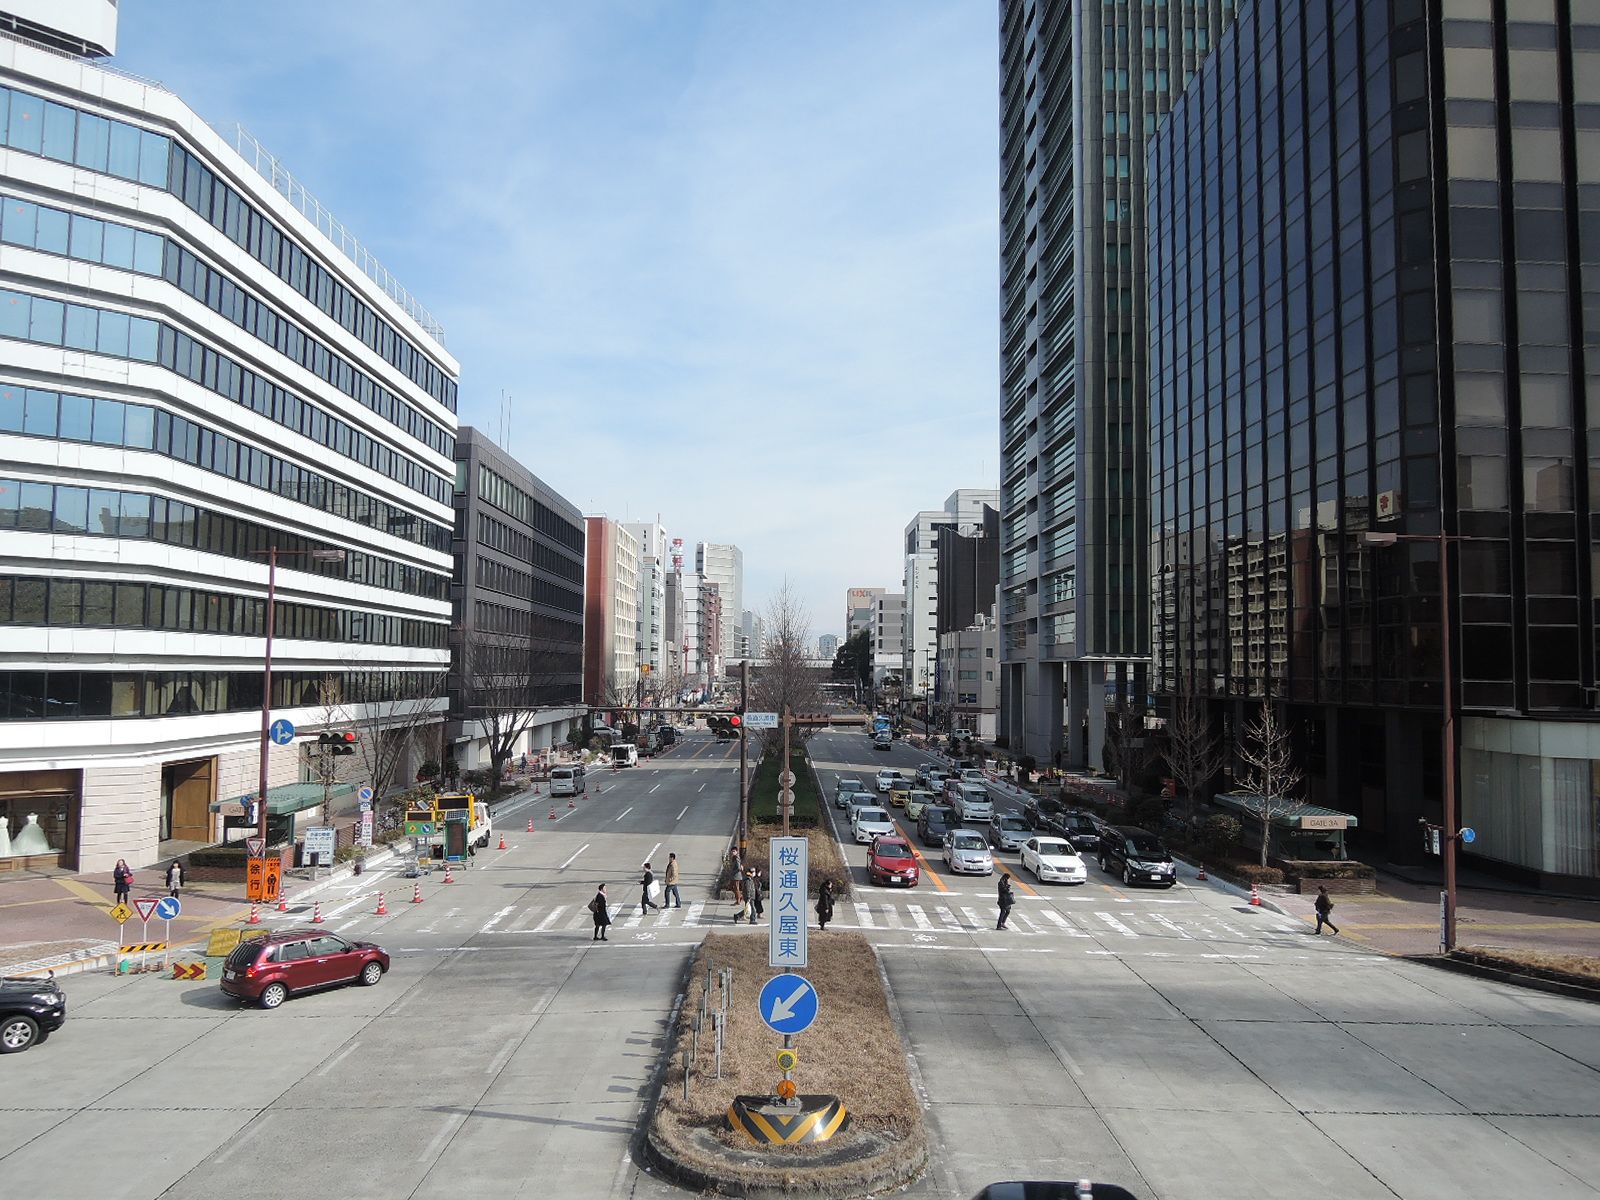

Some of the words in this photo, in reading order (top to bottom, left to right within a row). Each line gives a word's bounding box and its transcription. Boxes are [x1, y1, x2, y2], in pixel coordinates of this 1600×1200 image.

[250, 864, 261, 891] 徐行
[778, 846, 799, 959] 桜通久屋東
